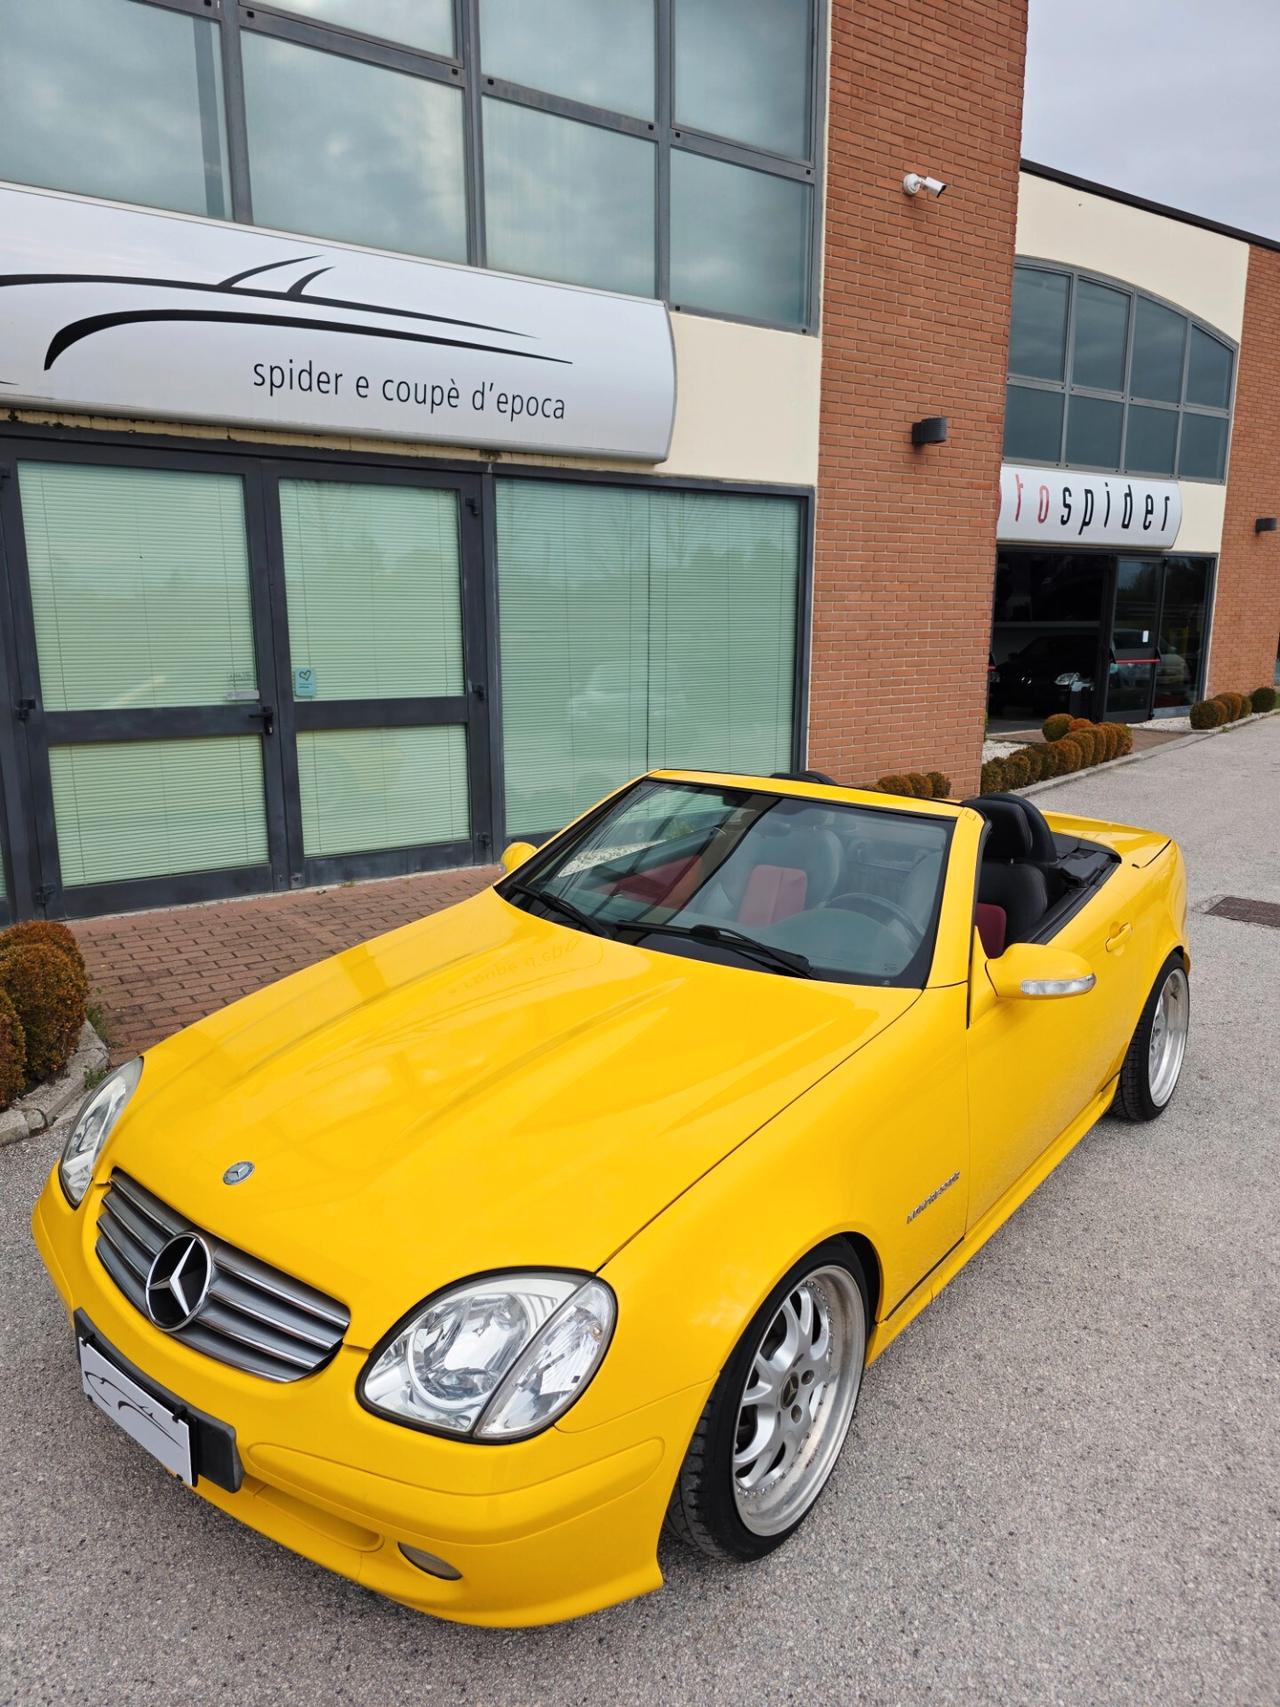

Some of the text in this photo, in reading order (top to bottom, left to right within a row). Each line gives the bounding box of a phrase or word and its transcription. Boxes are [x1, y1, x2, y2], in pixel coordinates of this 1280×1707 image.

[253, 358, 344, 397] spider
[355, 375, 370, 398] e
[382, 378, 460, 414] coupè
[999, 473, 1171, 536] tospider
